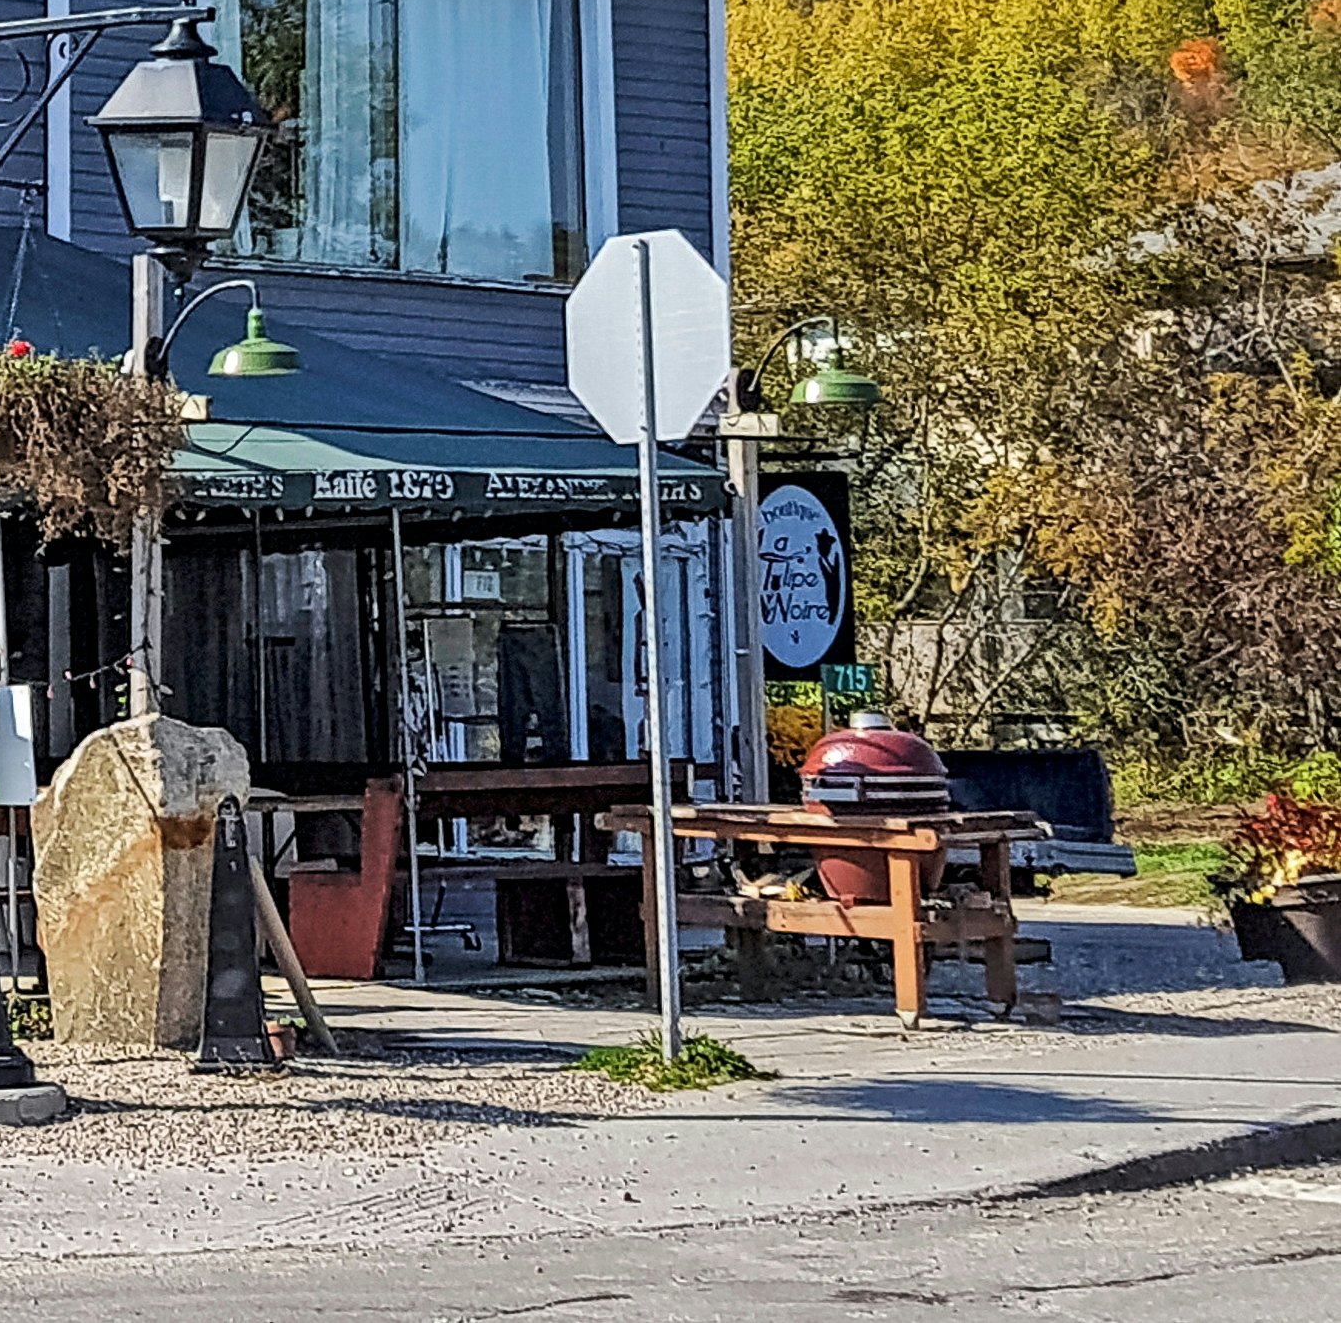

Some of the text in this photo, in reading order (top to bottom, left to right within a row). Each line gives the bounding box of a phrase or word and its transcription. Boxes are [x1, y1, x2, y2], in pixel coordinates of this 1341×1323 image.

[312, 470, 454, 500] Kaffé 1870
[833, 664, 868, 692] 715
